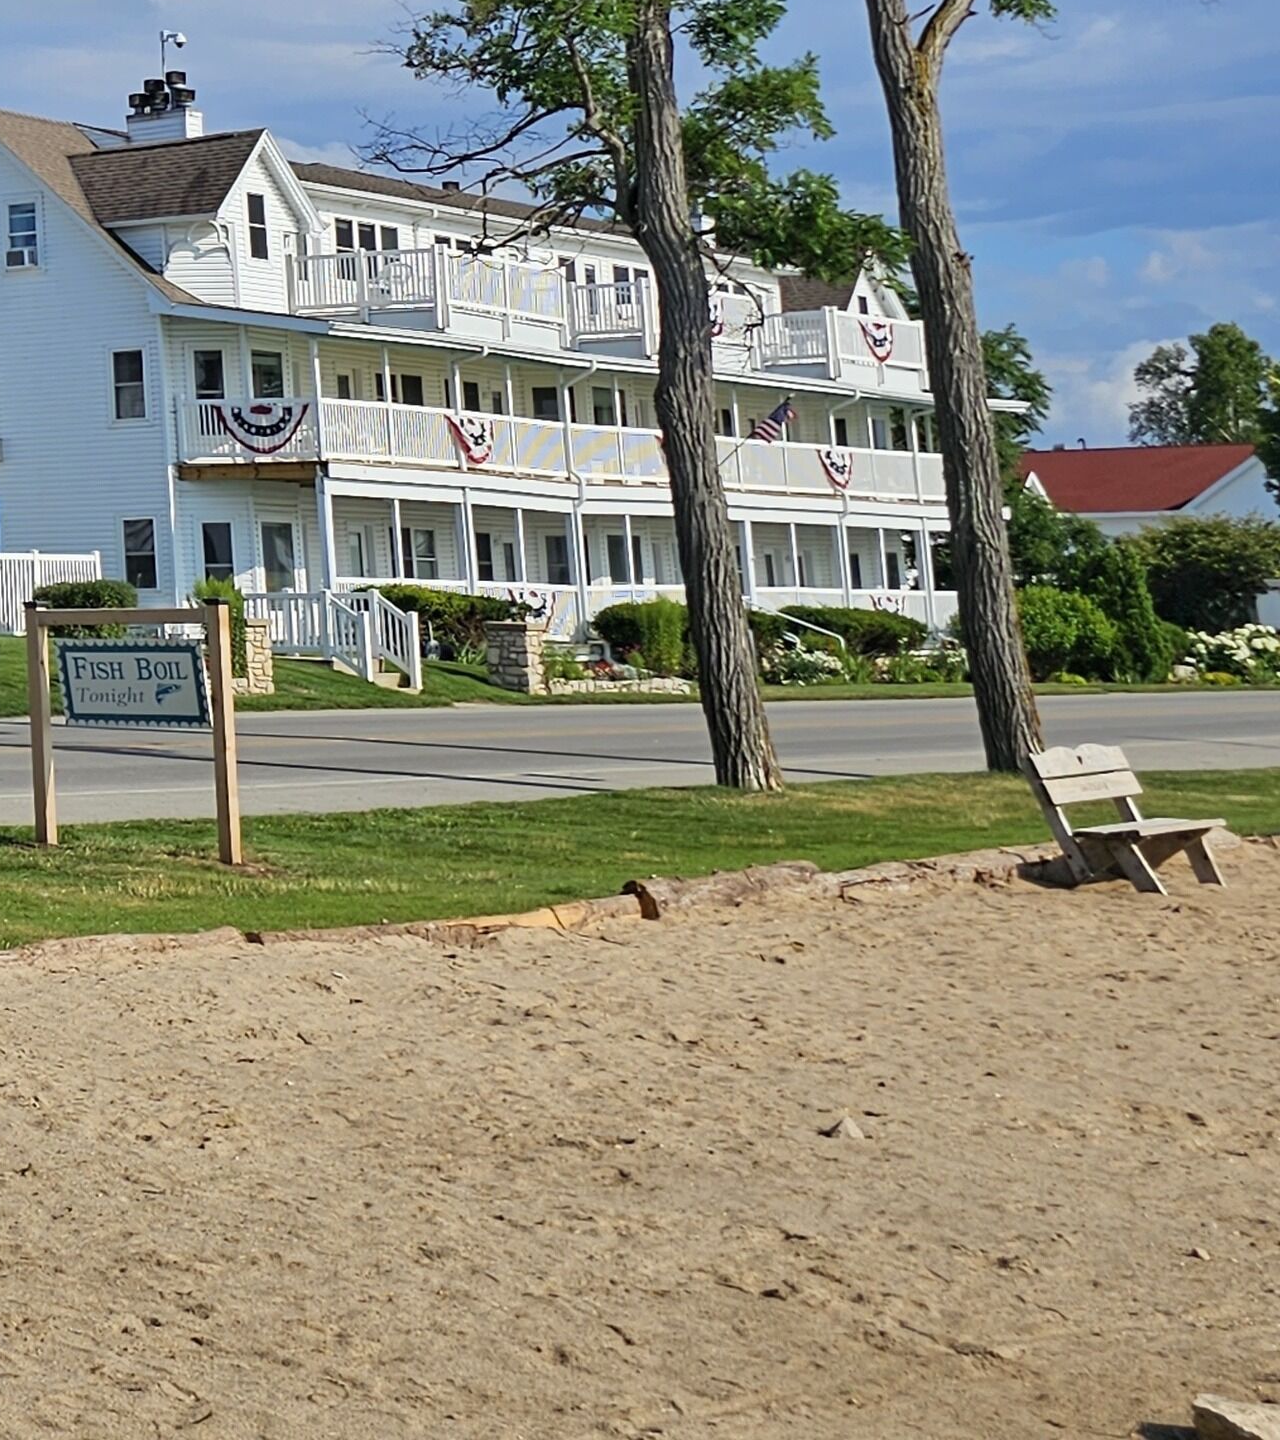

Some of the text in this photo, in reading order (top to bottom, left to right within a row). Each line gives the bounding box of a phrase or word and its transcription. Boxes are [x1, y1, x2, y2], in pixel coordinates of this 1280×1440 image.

[72, 656, 188, 681] FISH BOIL
[76, 687, 144, 707] Tonight
